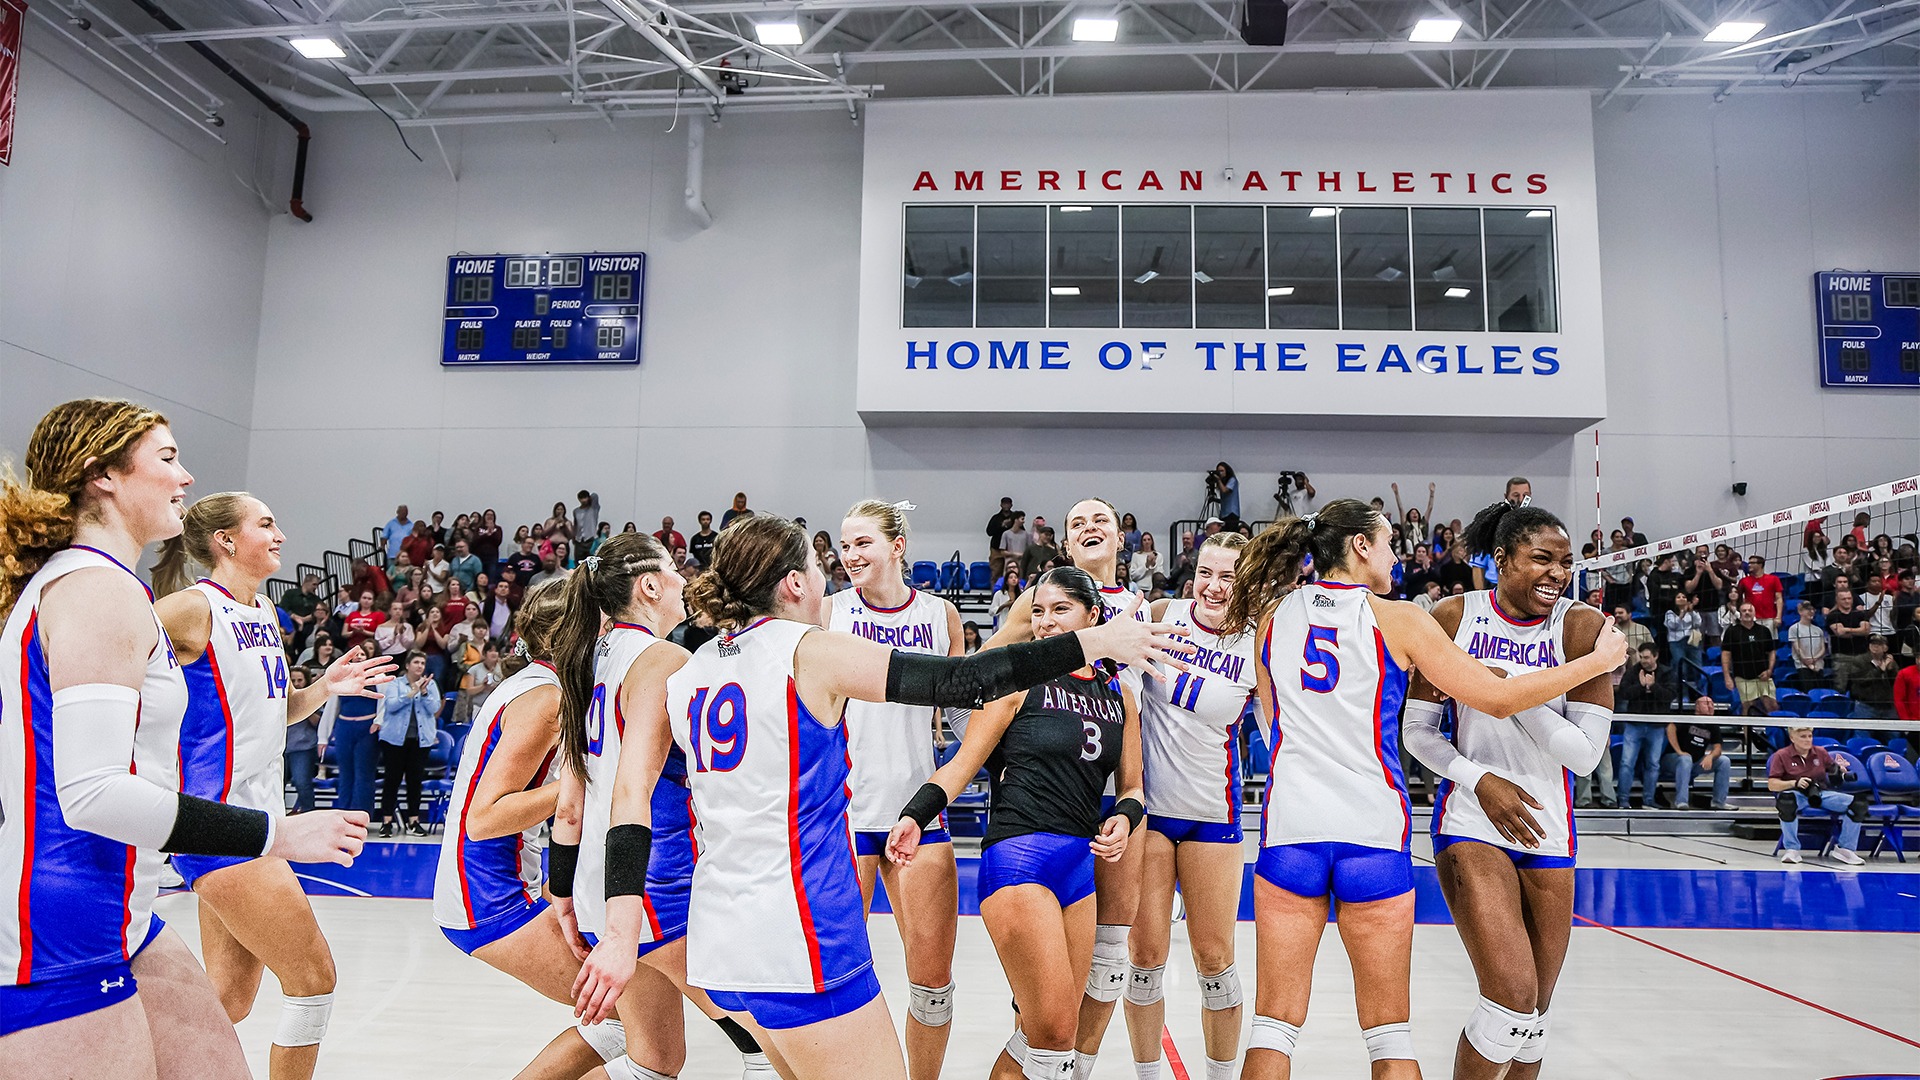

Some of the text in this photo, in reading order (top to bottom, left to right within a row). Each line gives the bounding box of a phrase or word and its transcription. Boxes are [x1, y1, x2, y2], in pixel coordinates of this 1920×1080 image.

[913, 170, 1548, 194] AMERICAN ATHLETICS
[455, 260, 495, 274] HOME
[589, 257, 640, 271] VISITOR
[1829, 277, 1871, 291] HOME
[551, 300, 581, 309] PERIOD
[460, 321, 482, 329] FOULS
[514, 319, 572, 328] PLAYER FOULS
[1842, 341, 1866, 349] FOULS
[1902, 342, 1920, 350] PLAY
[526, 353, 551, 361] WEIGHT
[598, 352, 621, 360] MATCH
[905, 340, 1561, 376] HOME OF THE EAGLES
[1844, 375, 1868, 383] MATCH
[1892, 479, 1918, 496] AMERICAN
[1848, 490, 1872, 506] AMERICAN
[852, 620, 933, 650] AMERICAN
[1300, 624, 1340, 694] 5
[261, 655, 288, 699] 14
[1169, 671, 1206, 713] 11
[1042, 685, 1124, 724] AMERICAN
[687, 682, 748, 773] 19
[1079, 720, 1102, 761] 3
